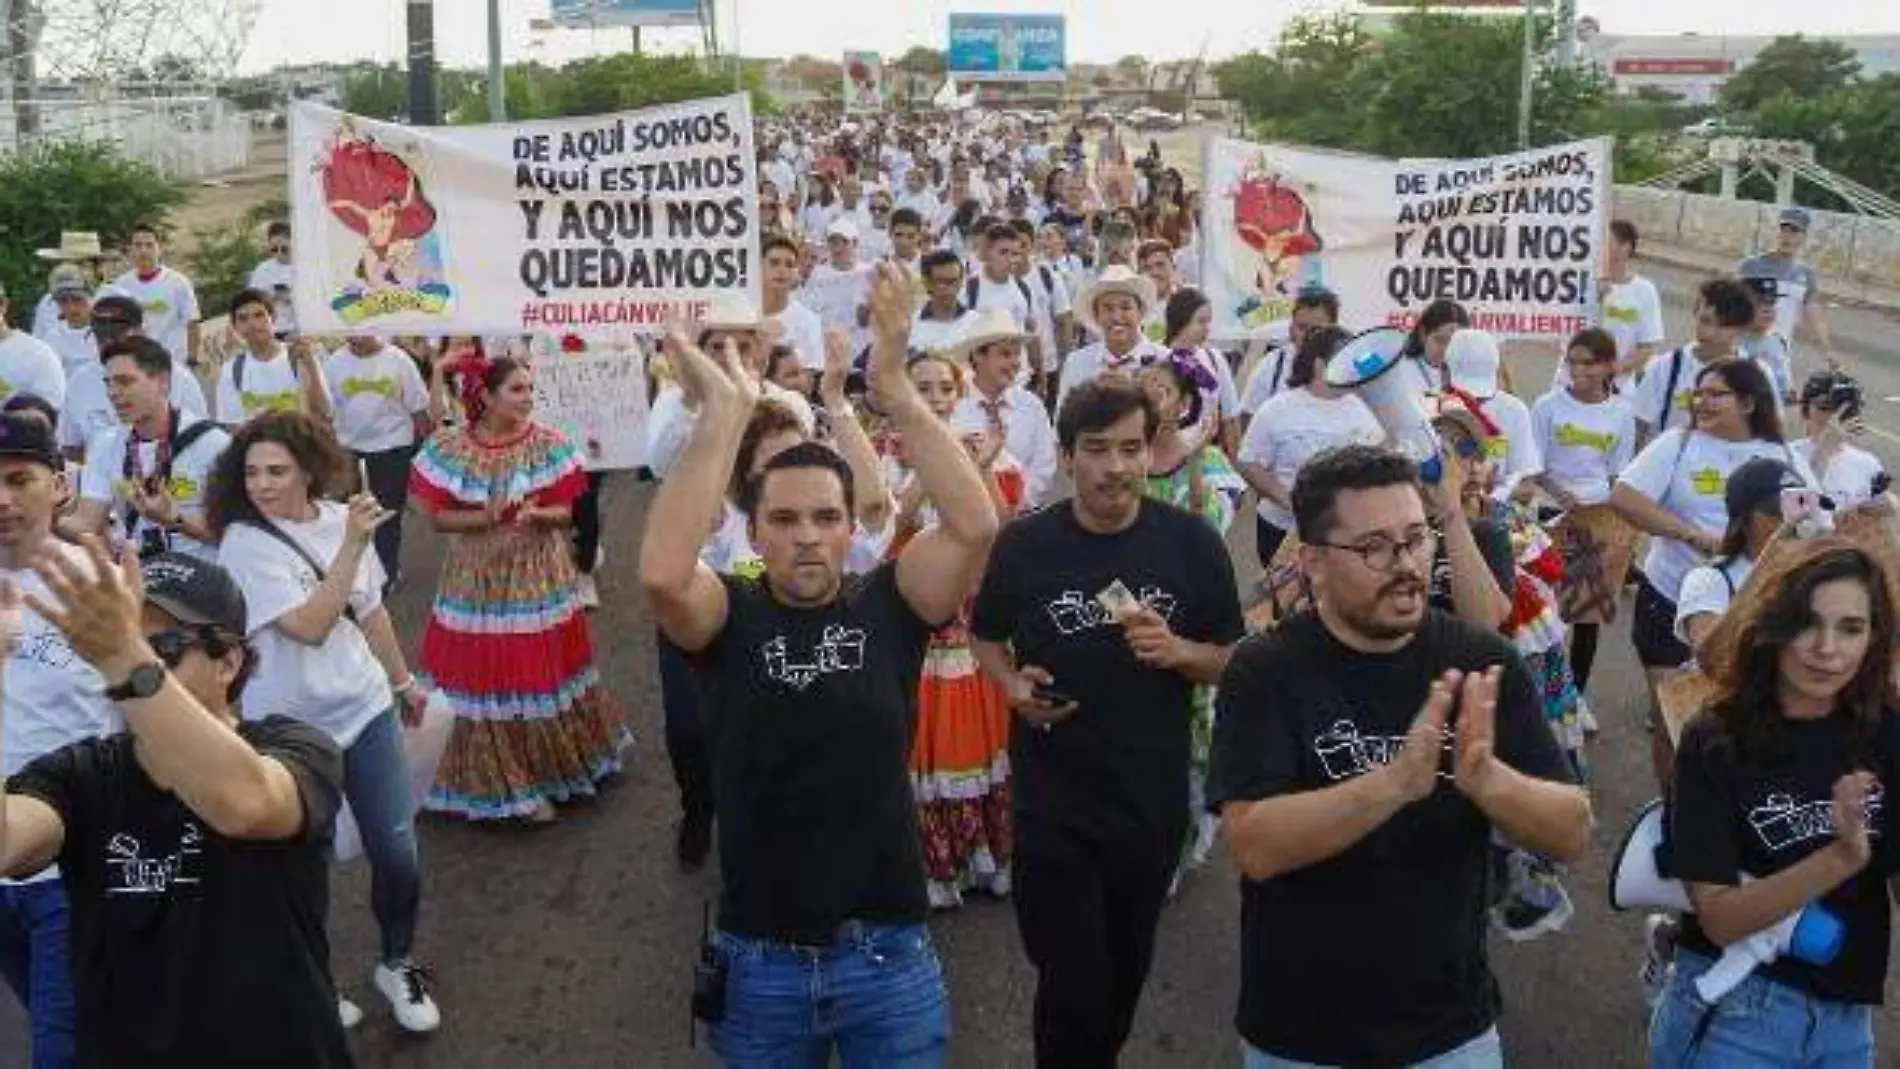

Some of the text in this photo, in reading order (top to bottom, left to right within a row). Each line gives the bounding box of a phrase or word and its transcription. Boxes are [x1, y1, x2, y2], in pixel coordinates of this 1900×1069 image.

[513, 111, 741, 162] DE AQUÍ SOMOS,
[515, 154, 745, 194] AQUÍ ESTAMOS
[1395, 173, 1426, 195] DE
[519, 192, 748, 246] Y AQUÍ NOS
[1467, 186, 1594, 216] ESTAMOS
[1395, 216, 1591, 264] Y AQUÍ NOS
[520, 248, 748, 297] QUEDAMOS!
[1387, 266, 1590, 307] QUEDAMOS!
